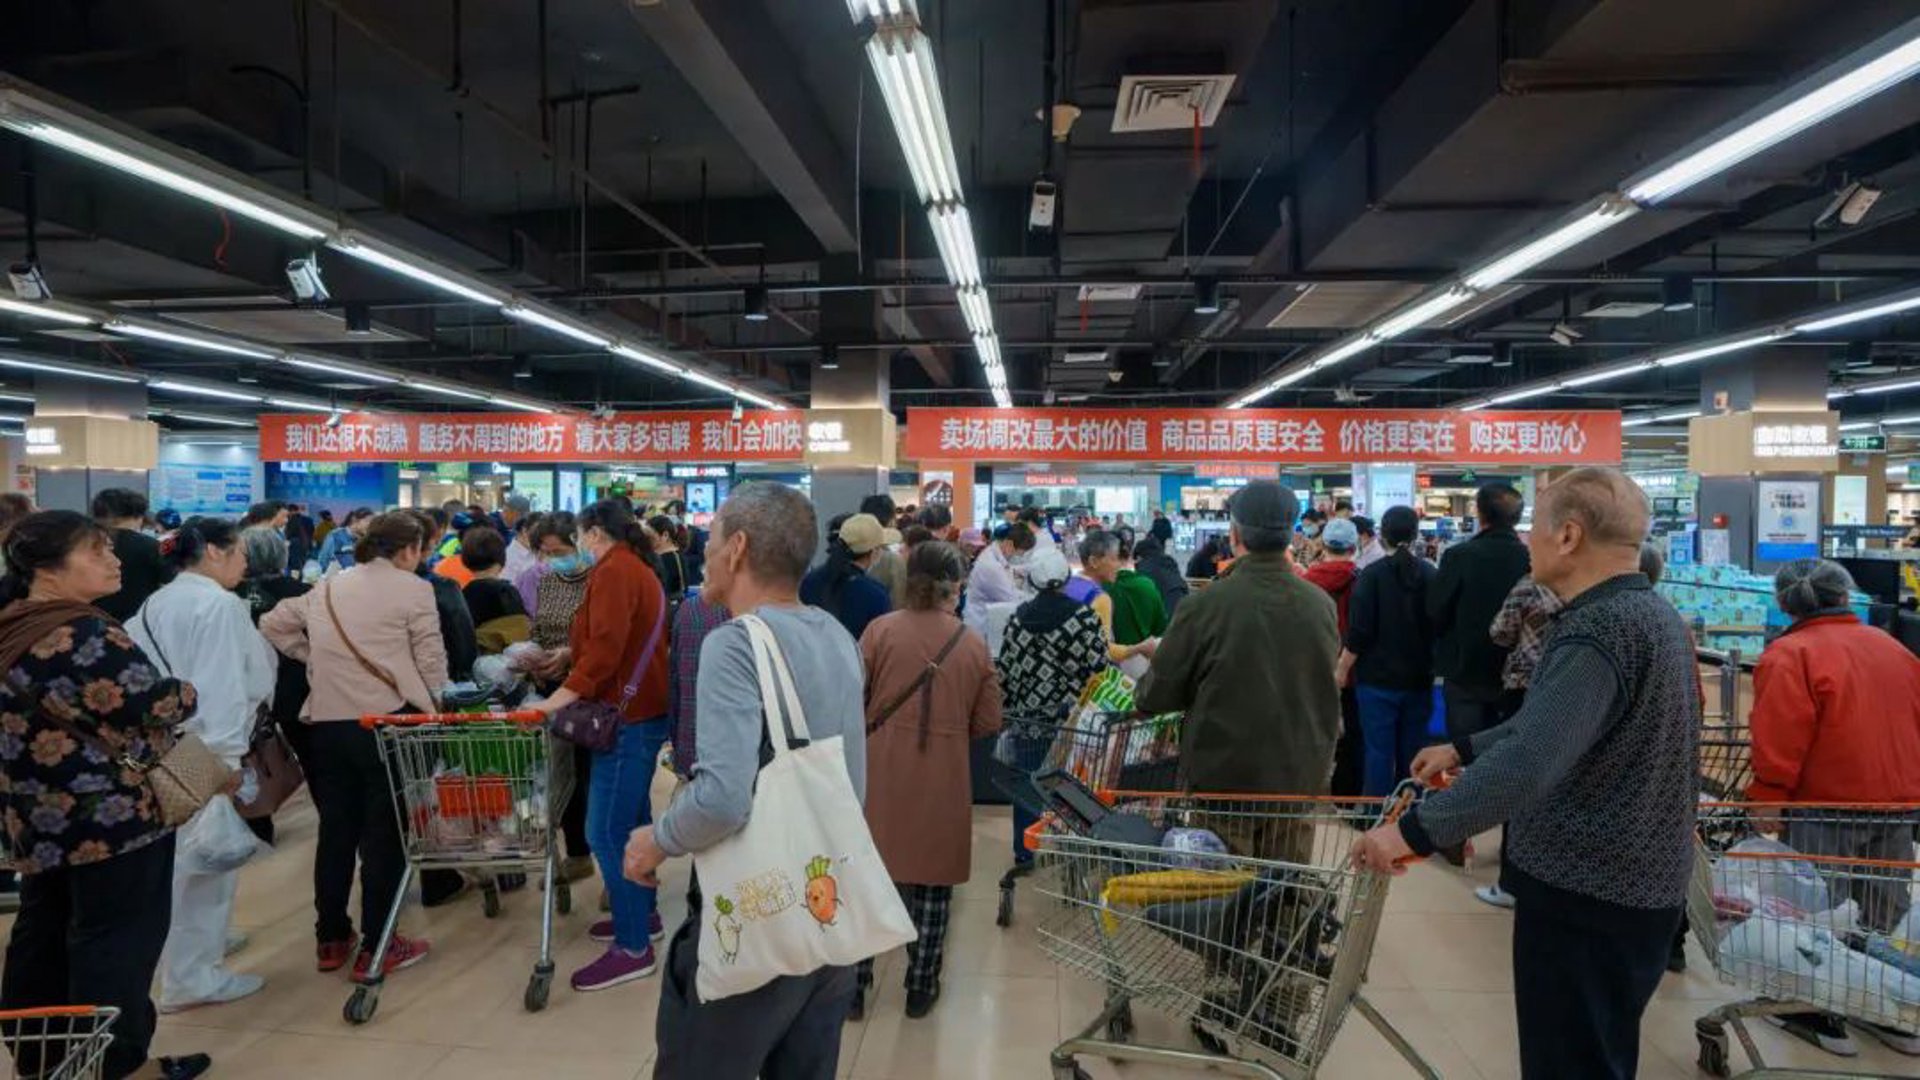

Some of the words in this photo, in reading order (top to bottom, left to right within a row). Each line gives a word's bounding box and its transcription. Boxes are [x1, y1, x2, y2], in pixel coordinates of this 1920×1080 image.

[285, 422, 409, 453] 我们还很不成熟
[418, 421, 565, 453] 服务不周到的地方
[575, 421, 691, 452] 请大家多谅解
[701, 420, 803, 452] 我们会加快
[940, 418, 1147, 452] 卖场调改最大的价值
[1161, 418, 1325, 453] 商品品质更安全
[1339, 419, 1456, 453] 价格更实在
[1469, 420, 1587, 454] 购买更放心
